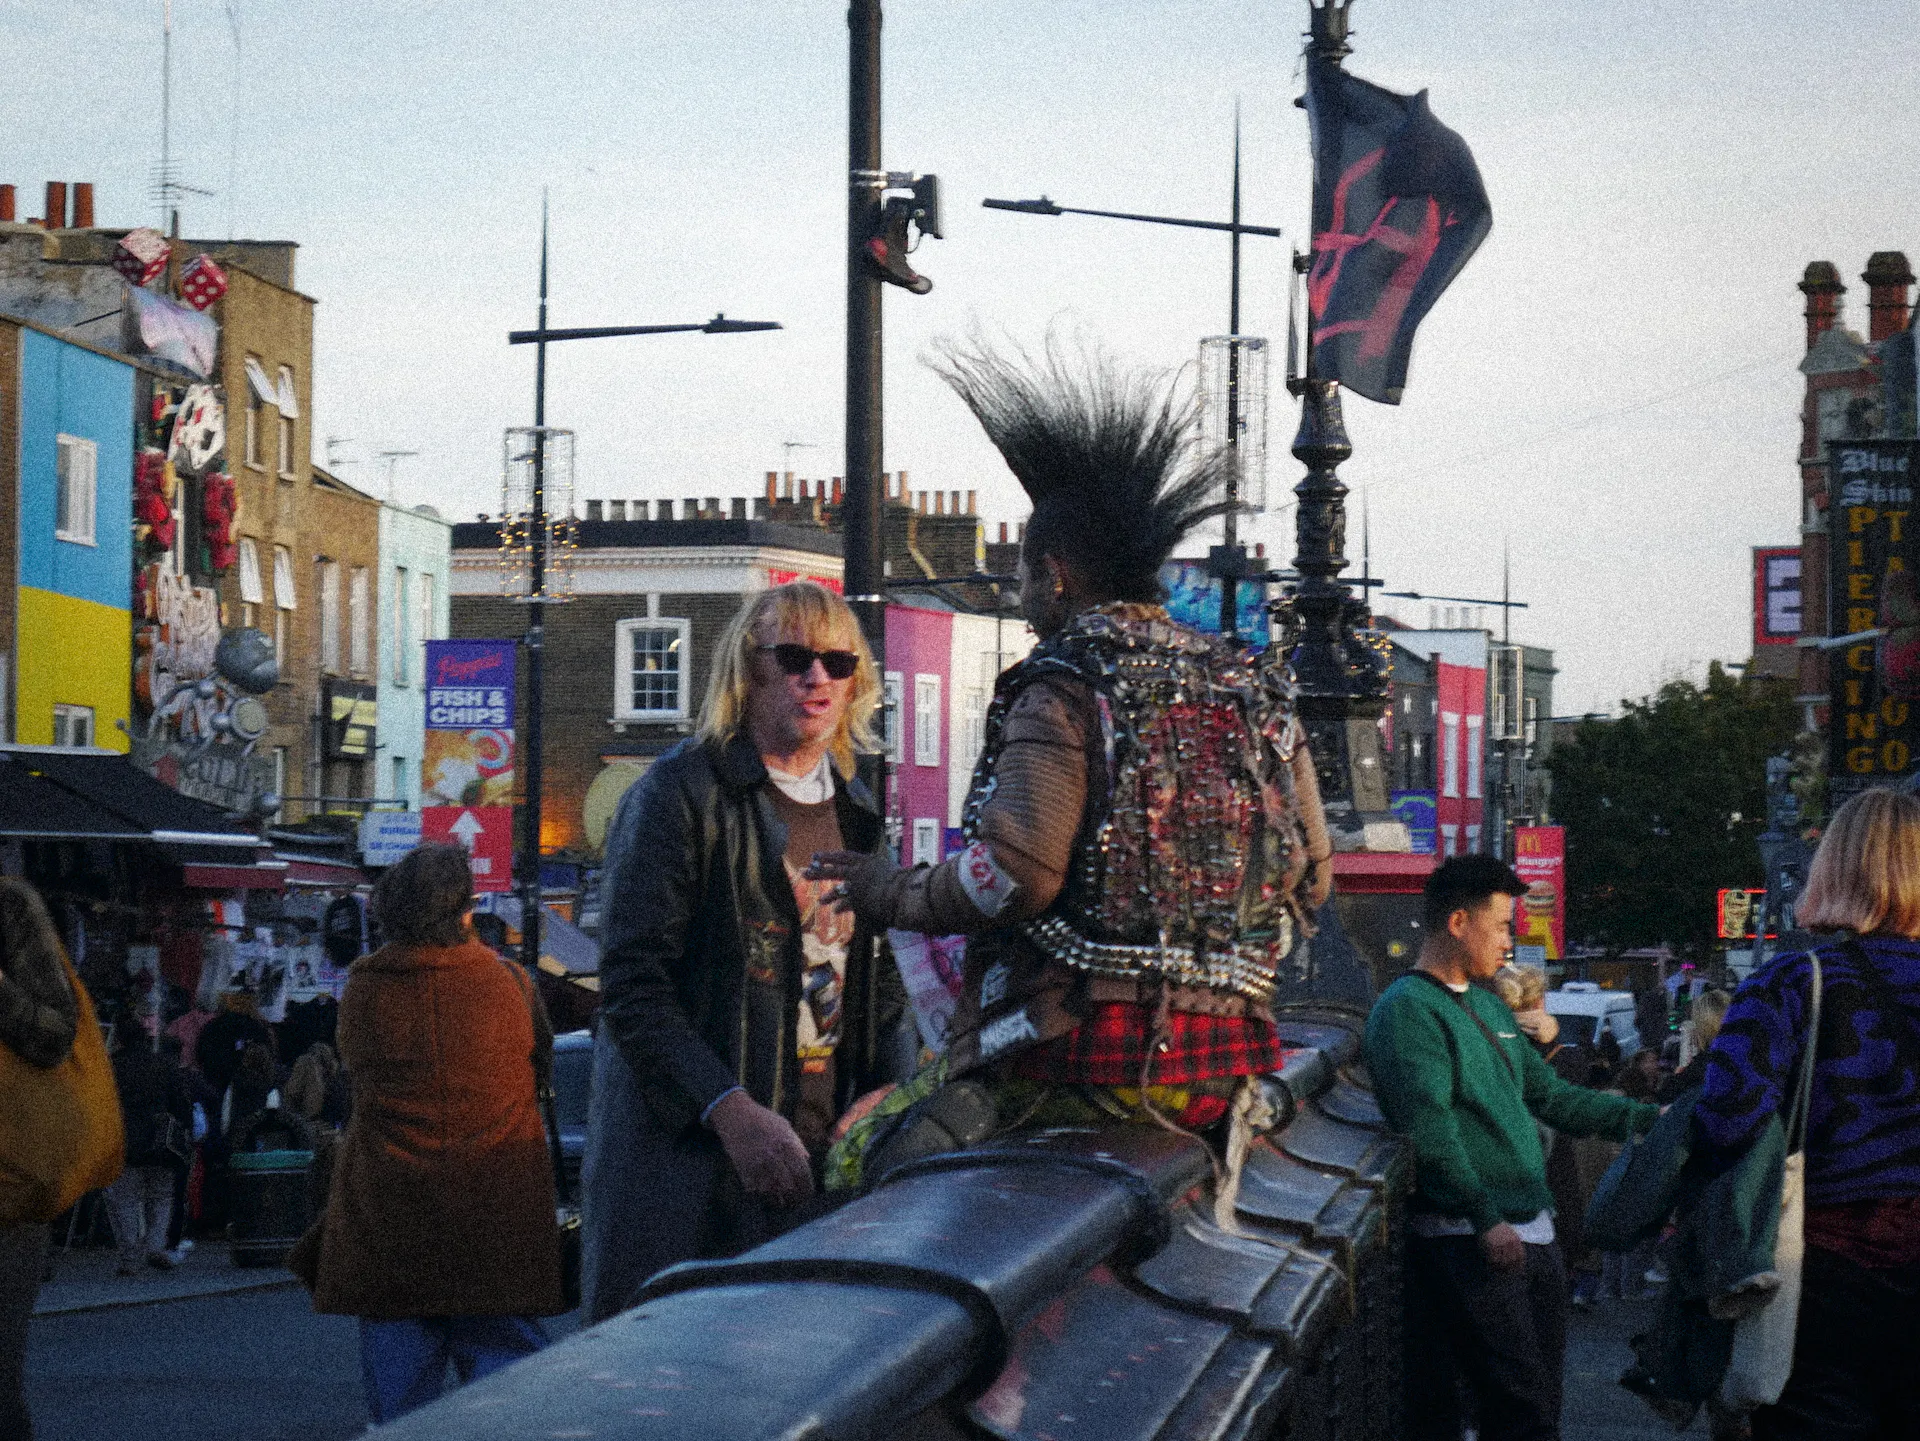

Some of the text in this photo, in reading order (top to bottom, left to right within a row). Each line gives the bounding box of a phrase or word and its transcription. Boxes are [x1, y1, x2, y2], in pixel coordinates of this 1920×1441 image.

[430, 690, 506, 706] FISH &
[1845, 507, 1877, 774] PIERCING
[1882, 510, 1911, 772] TAOO
[430, 707, 507, 724] CHIPS
